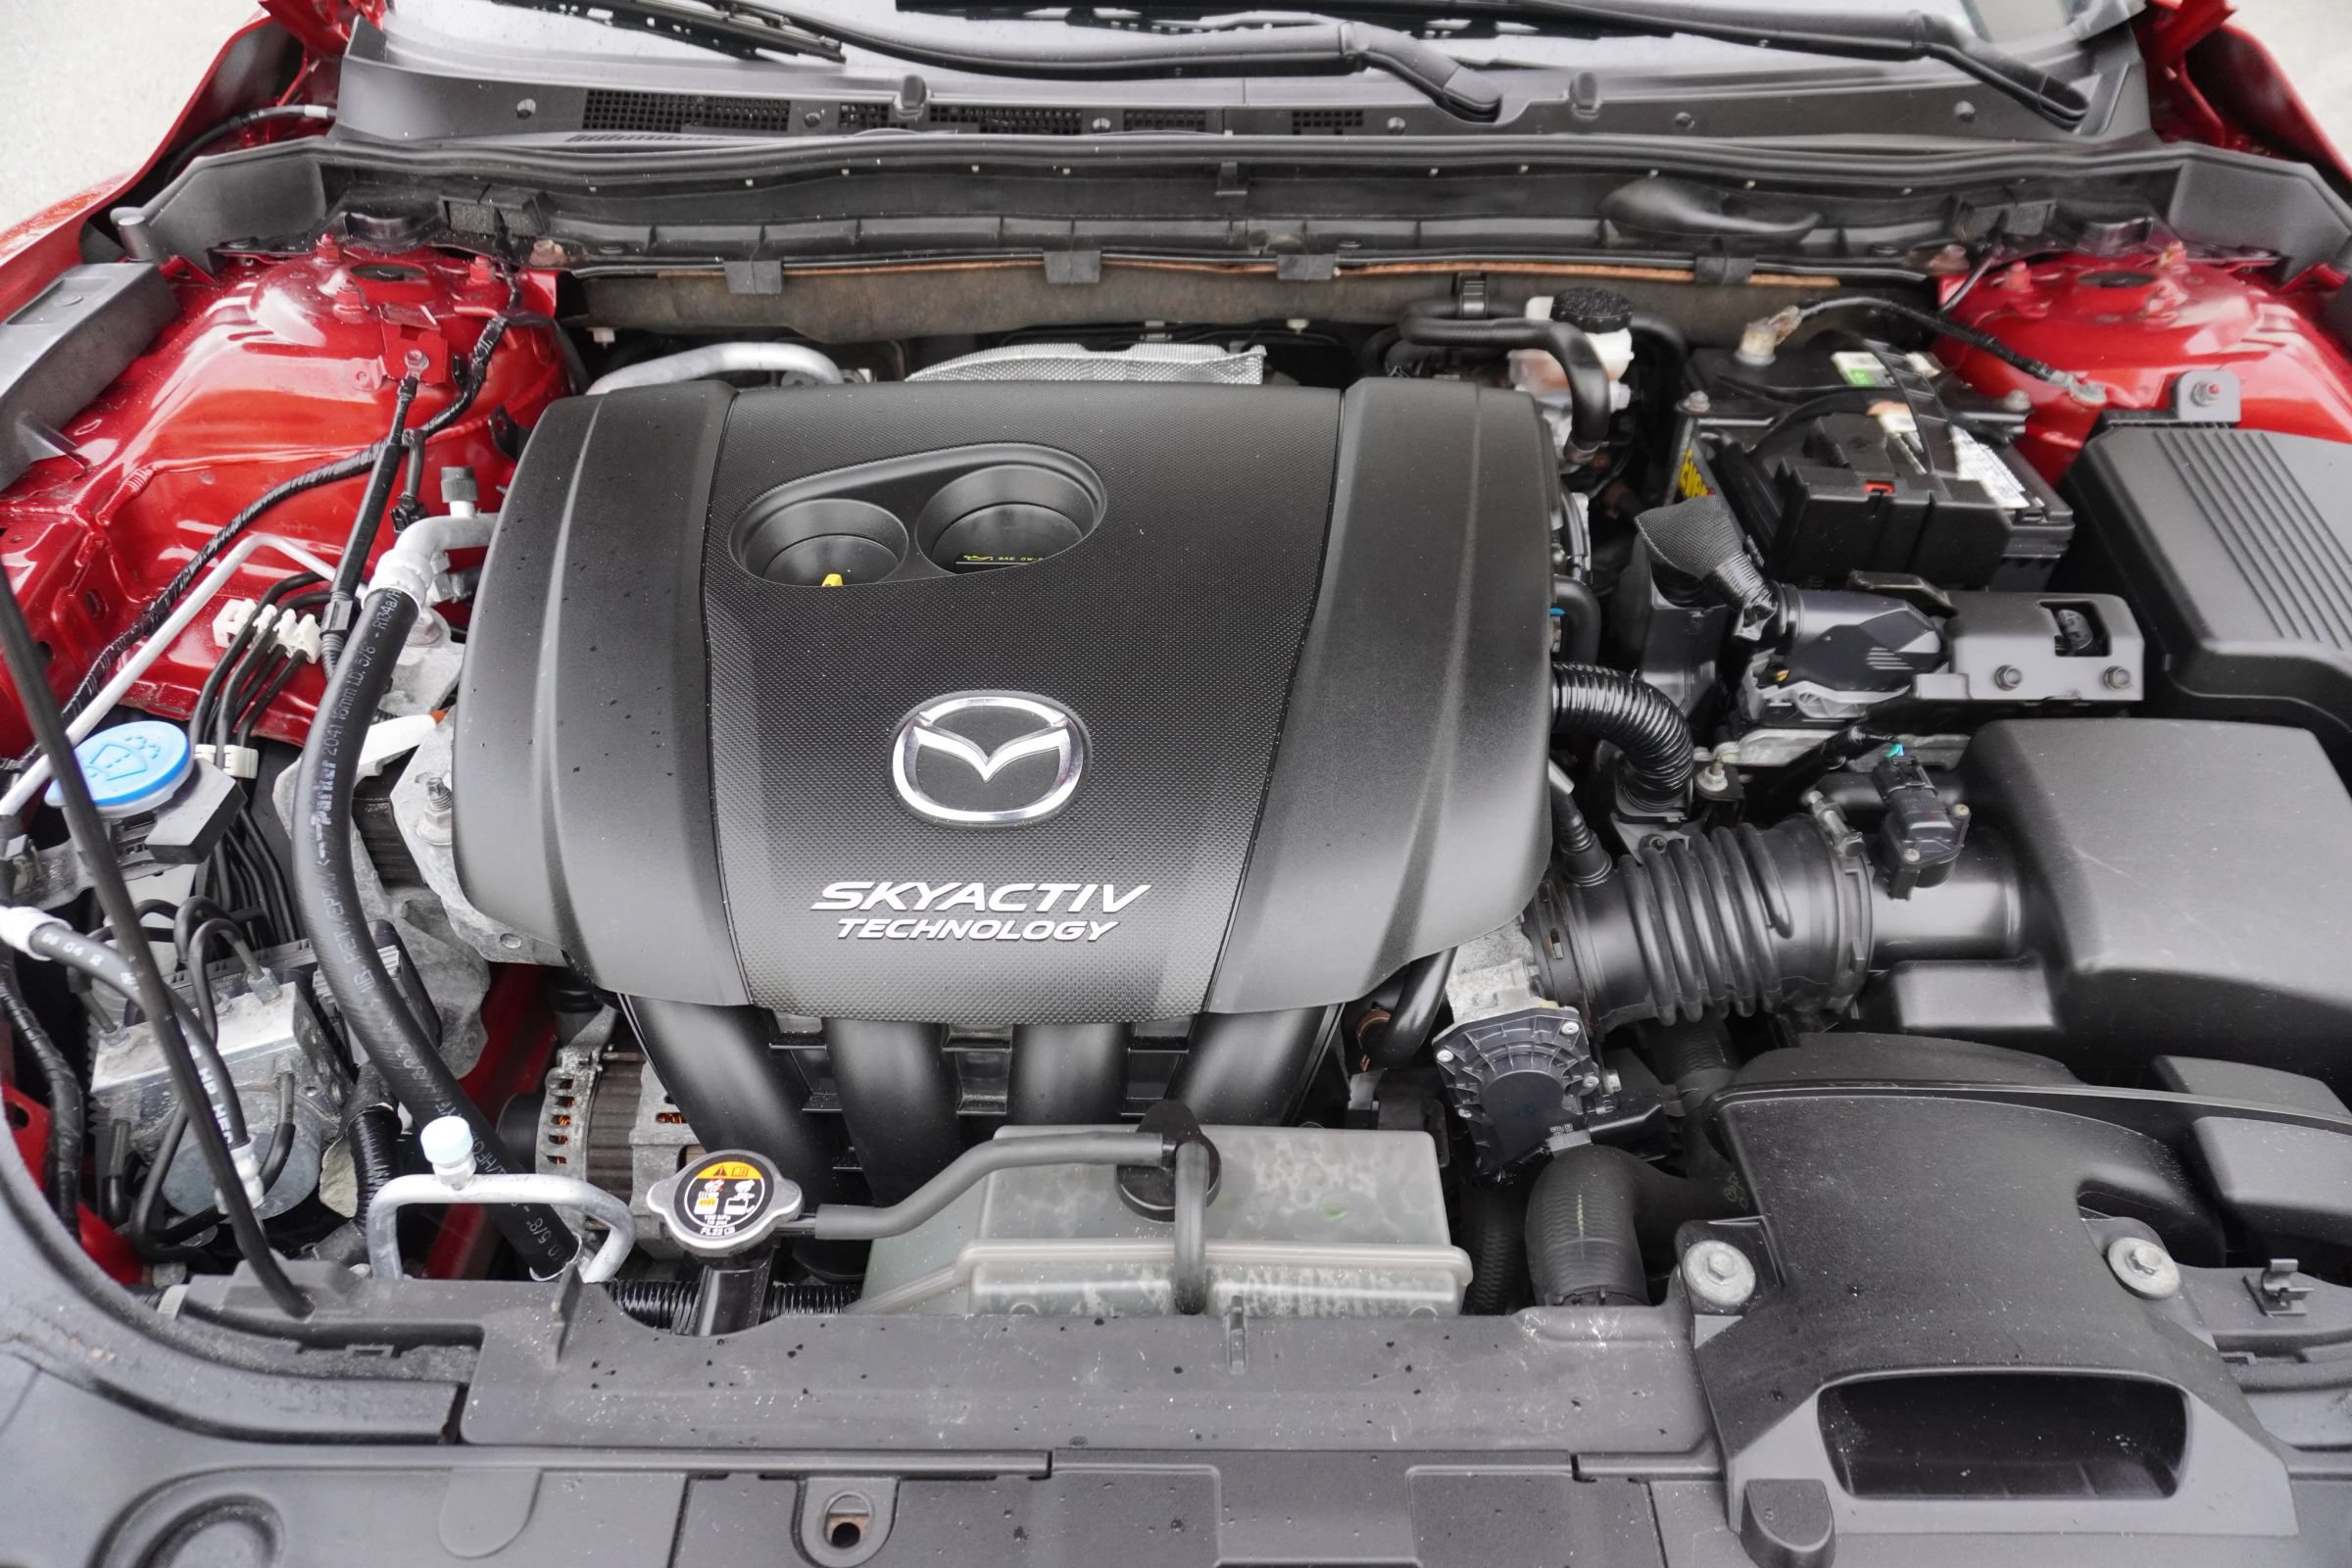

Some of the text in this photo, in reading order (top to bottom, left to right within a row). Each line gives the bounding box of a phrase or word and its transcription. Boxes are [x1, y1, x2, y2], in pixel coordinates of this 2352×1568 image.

[332, 685, 359, 720] 16mm
[322, 723, 344, 756] 2041
[311, 760, 337, 826] Parker
[810, 881, 1152, 913] SKYACTIV
[837, 917, 1120, 942] TECHNOLOGY
